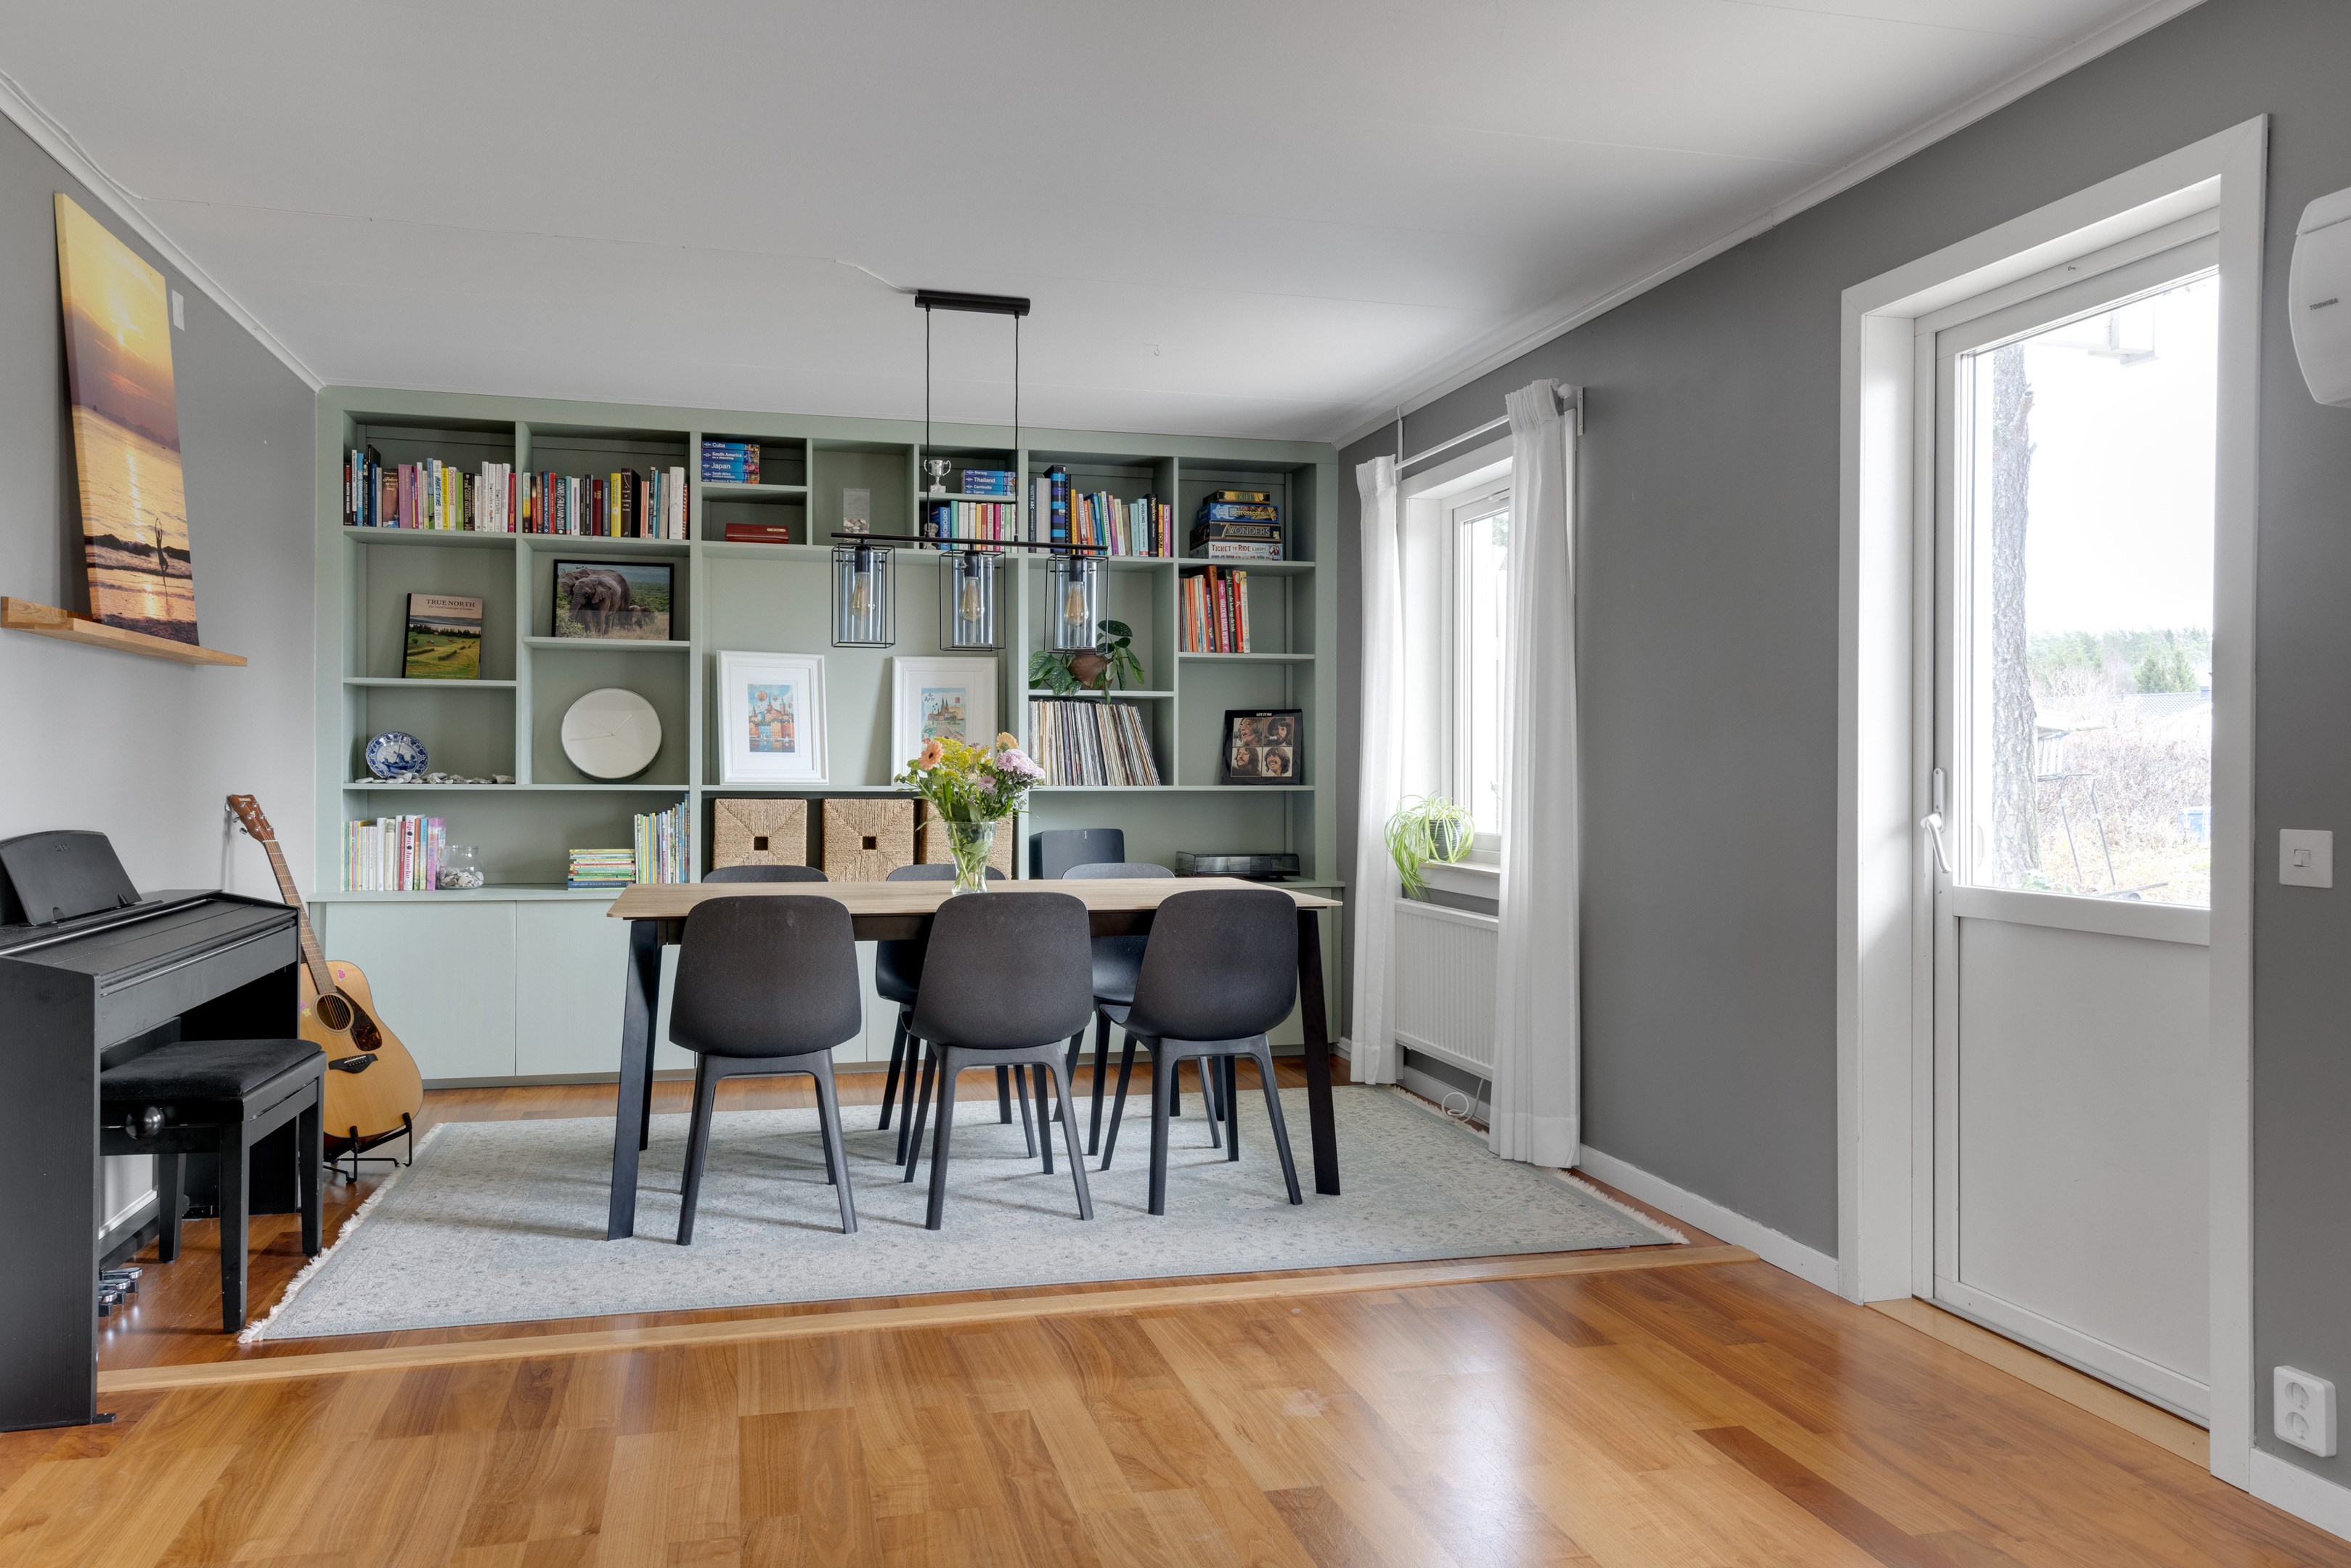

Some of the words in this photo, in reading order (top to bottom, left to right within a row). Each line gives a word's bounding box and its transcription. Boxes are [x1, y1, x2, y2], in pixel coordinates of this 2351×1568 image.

[2309, 298, 2338, 310] TOSHIBA
[1220, 522, 1230, 538] 7
[1227, 527, 1270, 535] WONDERS
